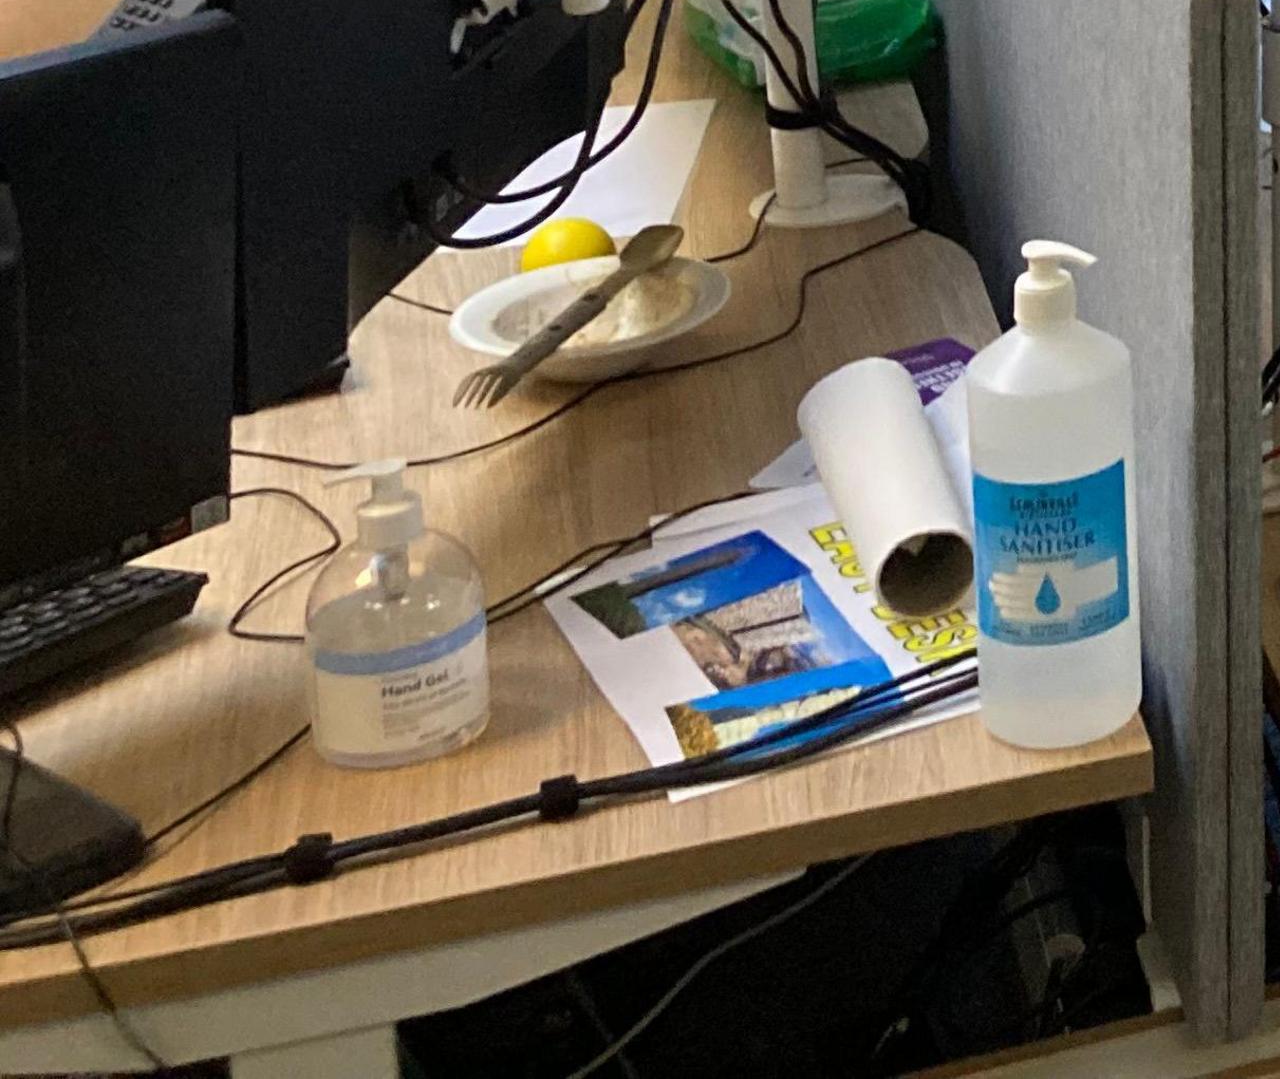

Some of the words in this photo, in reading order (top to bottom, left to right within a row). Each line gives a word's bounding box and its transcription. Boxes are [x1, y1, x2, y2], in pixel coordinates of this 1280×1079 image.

[1015, 517, 1076, 537] HAND
[1000, 528, 1096, 556] SANITISER
[381, 677, 421, 699] Hand
[426, 668, 448, 687] Gel
